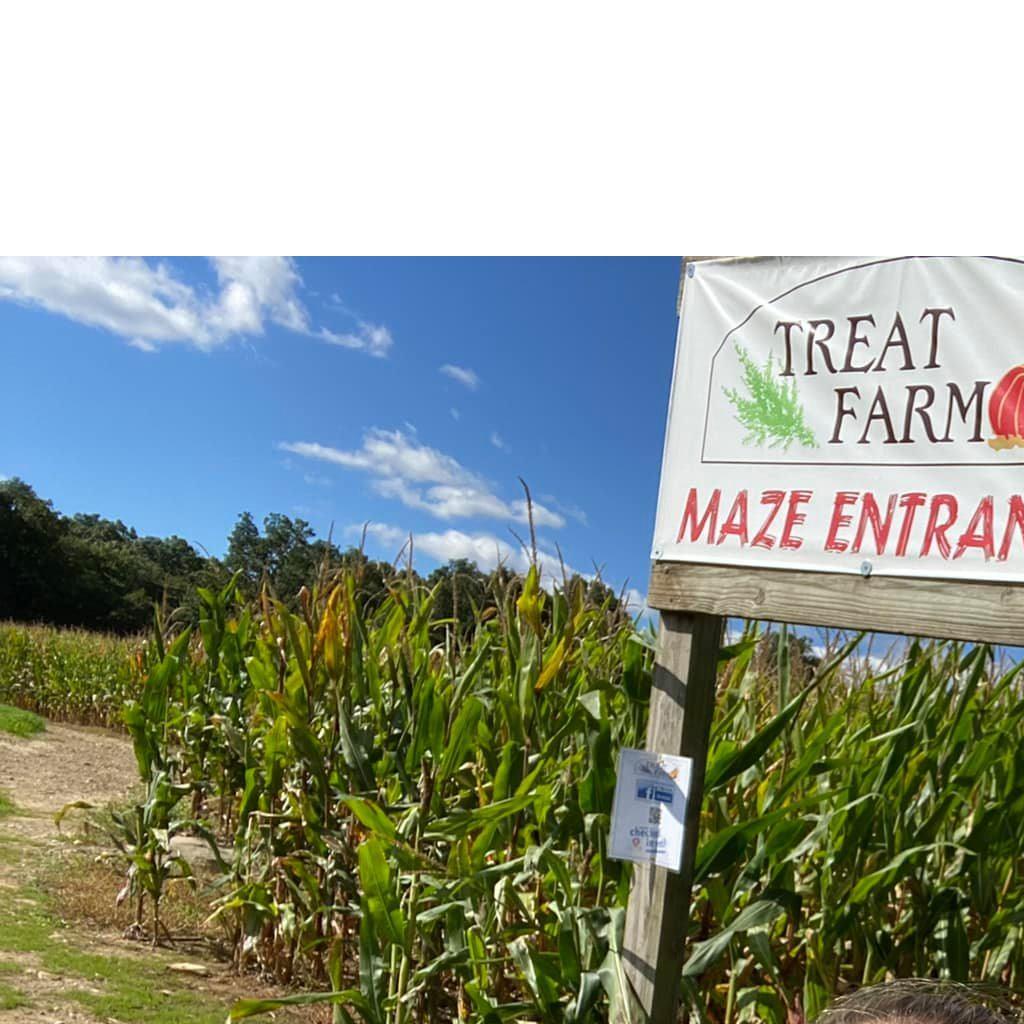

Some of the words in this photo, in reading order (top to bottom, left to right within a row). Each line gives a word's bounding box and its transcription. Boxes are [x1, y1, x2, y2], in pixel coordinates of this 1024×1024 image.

[774, 307, 955, 377] TREAT
[828, 380, 991, 445] FARM
[676, 487, 813, 549] MAZE
